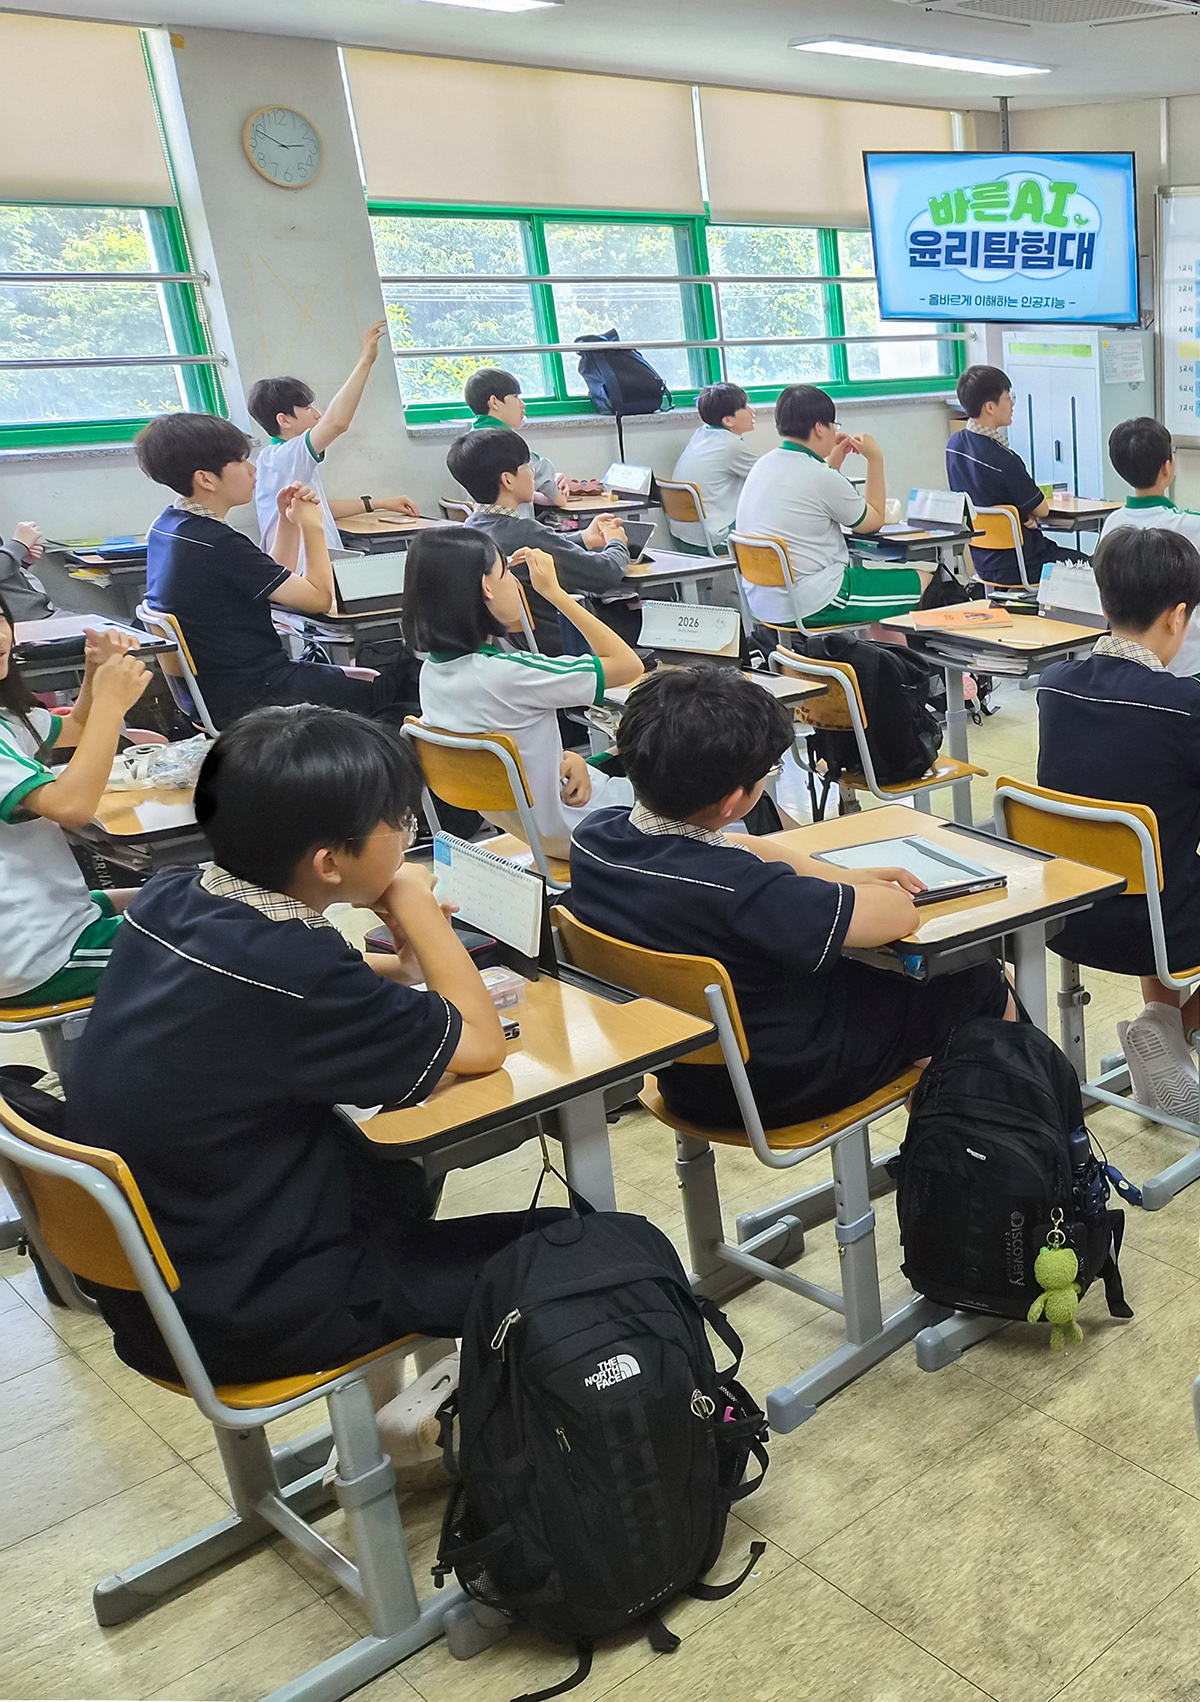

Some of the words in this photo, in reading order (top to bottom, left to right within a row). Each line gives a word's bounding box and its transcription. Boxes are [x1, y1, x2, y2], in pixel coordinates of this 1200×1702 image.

[261, 113, 272, 128] 11
[273, 109, 286, 126] 12
[291, 114, 296, 130] 1
[252, 123, 265, 140] 10
[301, 123, 310, 140] 2
[249, 137, 257, 152] 9
[308, 139, 318, 155] 3
[257, 152, 267, 168] 8
[305, 154, 314, 168] 4
[270, 162, 278, 178] 7
[283, 167, 293, 182] 6
[297, 163, 307, 178] 5
[928, 181, 1077, 227] 바른AI
[908, 230, 1096, 270] 윤리탐험대
[928, 294, 972, 307] 올바르게
[974, 294, 1018, 308] 이해하는
[1021, 295, 1066, 309] 인공지능
[678, 616, 700, 628] 2026
[597, 1356, 618, 1372] THE
[584, 1364, 620, 1387] NORTH
[595, 1373, 623, 1391] FACE
